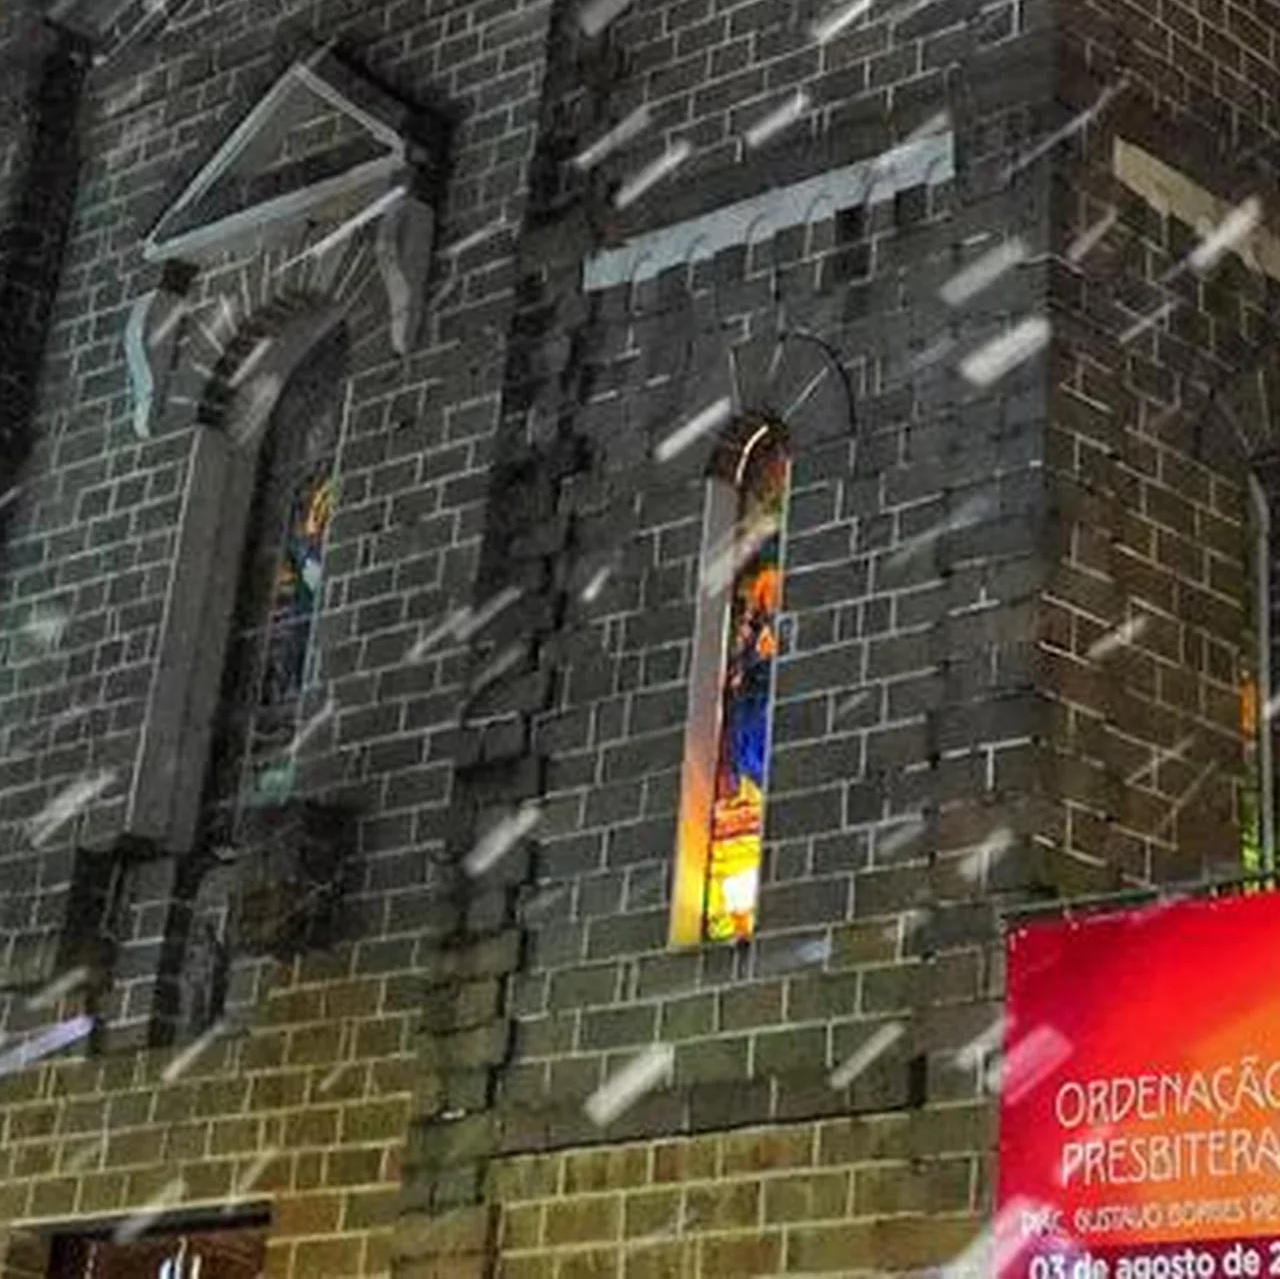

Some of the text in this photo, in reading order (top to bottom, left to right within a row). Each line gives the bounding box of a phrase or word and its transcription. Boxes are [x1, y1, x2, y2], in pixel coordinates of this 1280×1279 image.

[1029, 1252, 1067, 1279] 03
[1073, 1251, 1110, 1279] de
[1115, 1246, 1217, 1279] agosto
[1222, 1242, 1261, 1277] de
